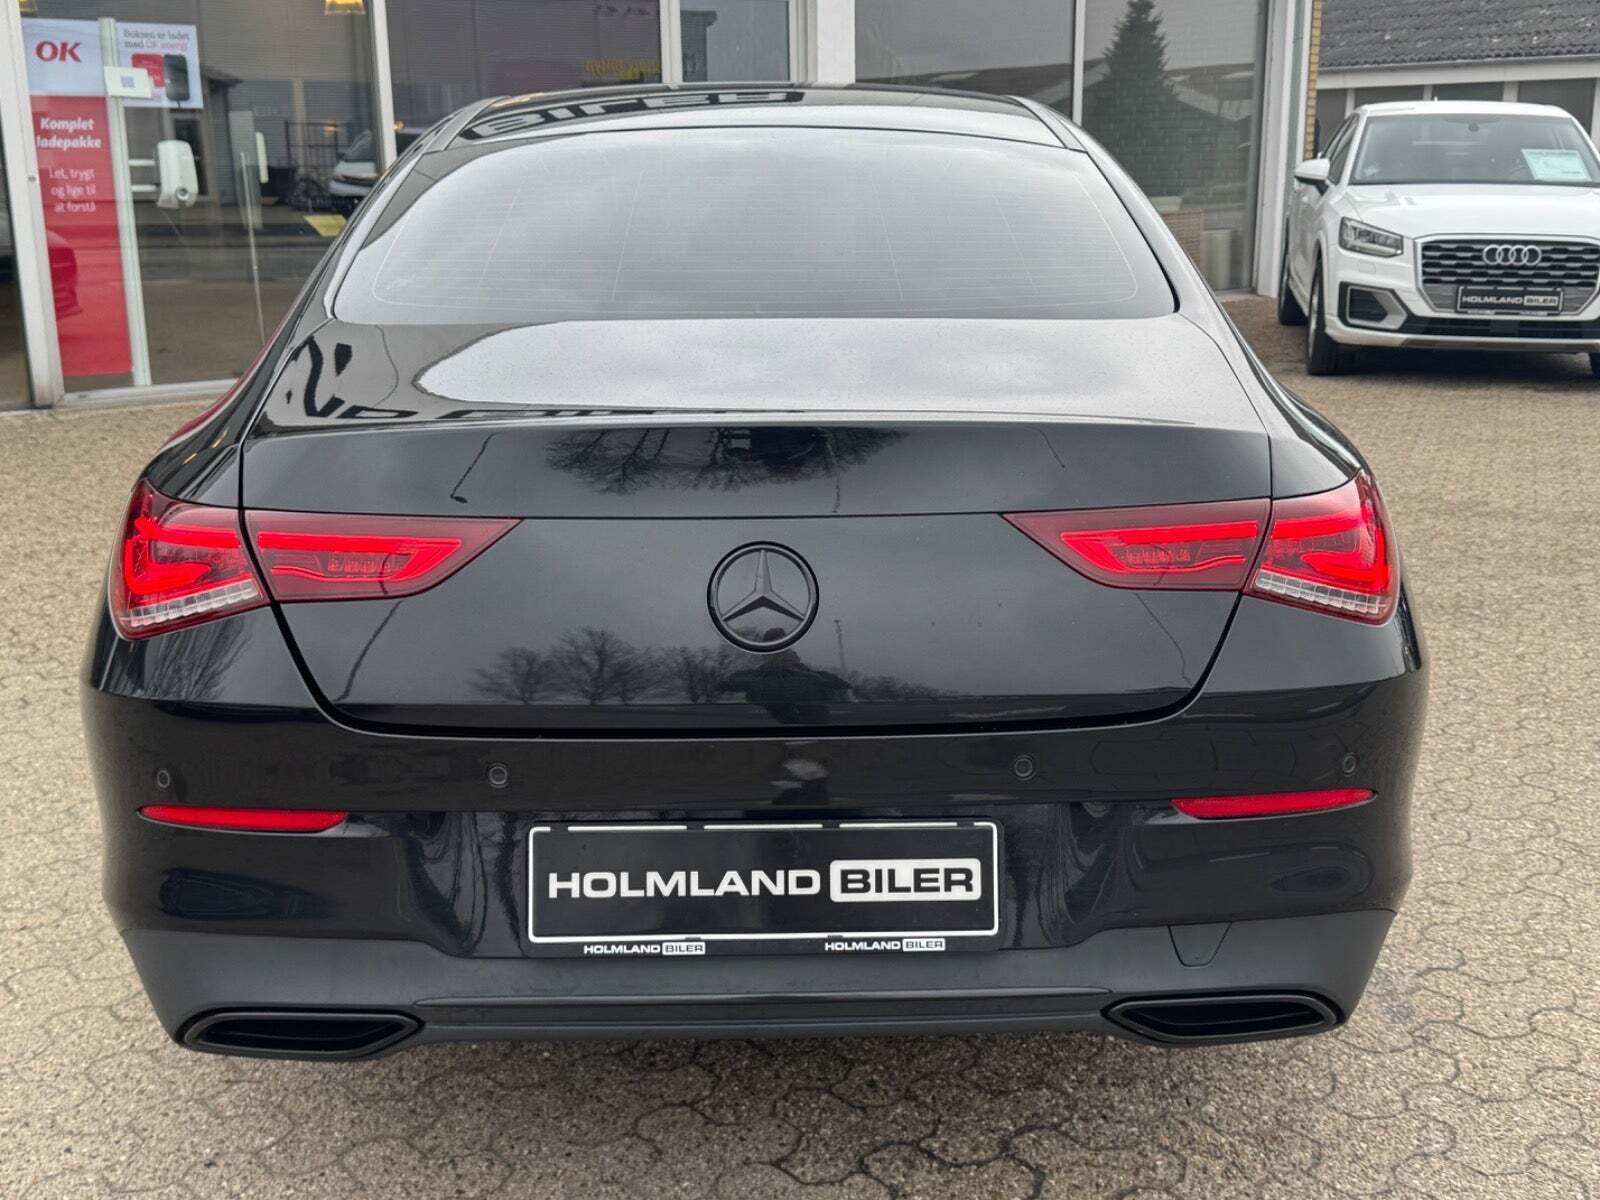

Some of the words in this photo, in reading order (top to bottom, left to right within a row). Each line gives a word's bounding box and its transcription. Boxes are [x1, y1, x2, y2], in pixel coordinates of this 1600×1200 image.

[35, 41, 82, 63] OK
[40, 117, 95, 134] Komplet
[36, 135, 102, 151] ladepakke
[49, 167, 68, 180] Let,
[69, 168, 95, 182] trygt
[51, 187, 65, 199] og
[67, 185, 86, 199] lige
[87, 184, 97, 196] til
[55, 203, 66, 213] at
[67, 201, 97, 213] forstå
[1461, 295, 1523, 305] HOLMLAND
[1525, 296, 1558, 305] BILER
[548, 868, 822, 899] HOLMLAND
[838, 866, 975, 895] BILER
[583, 944, 661, 955] HOLMLAND
[665, 943, 705, 954] BILER
[824, 941, 901, 952] HOLMLAND
[905, 940, 945, 951] BILER
